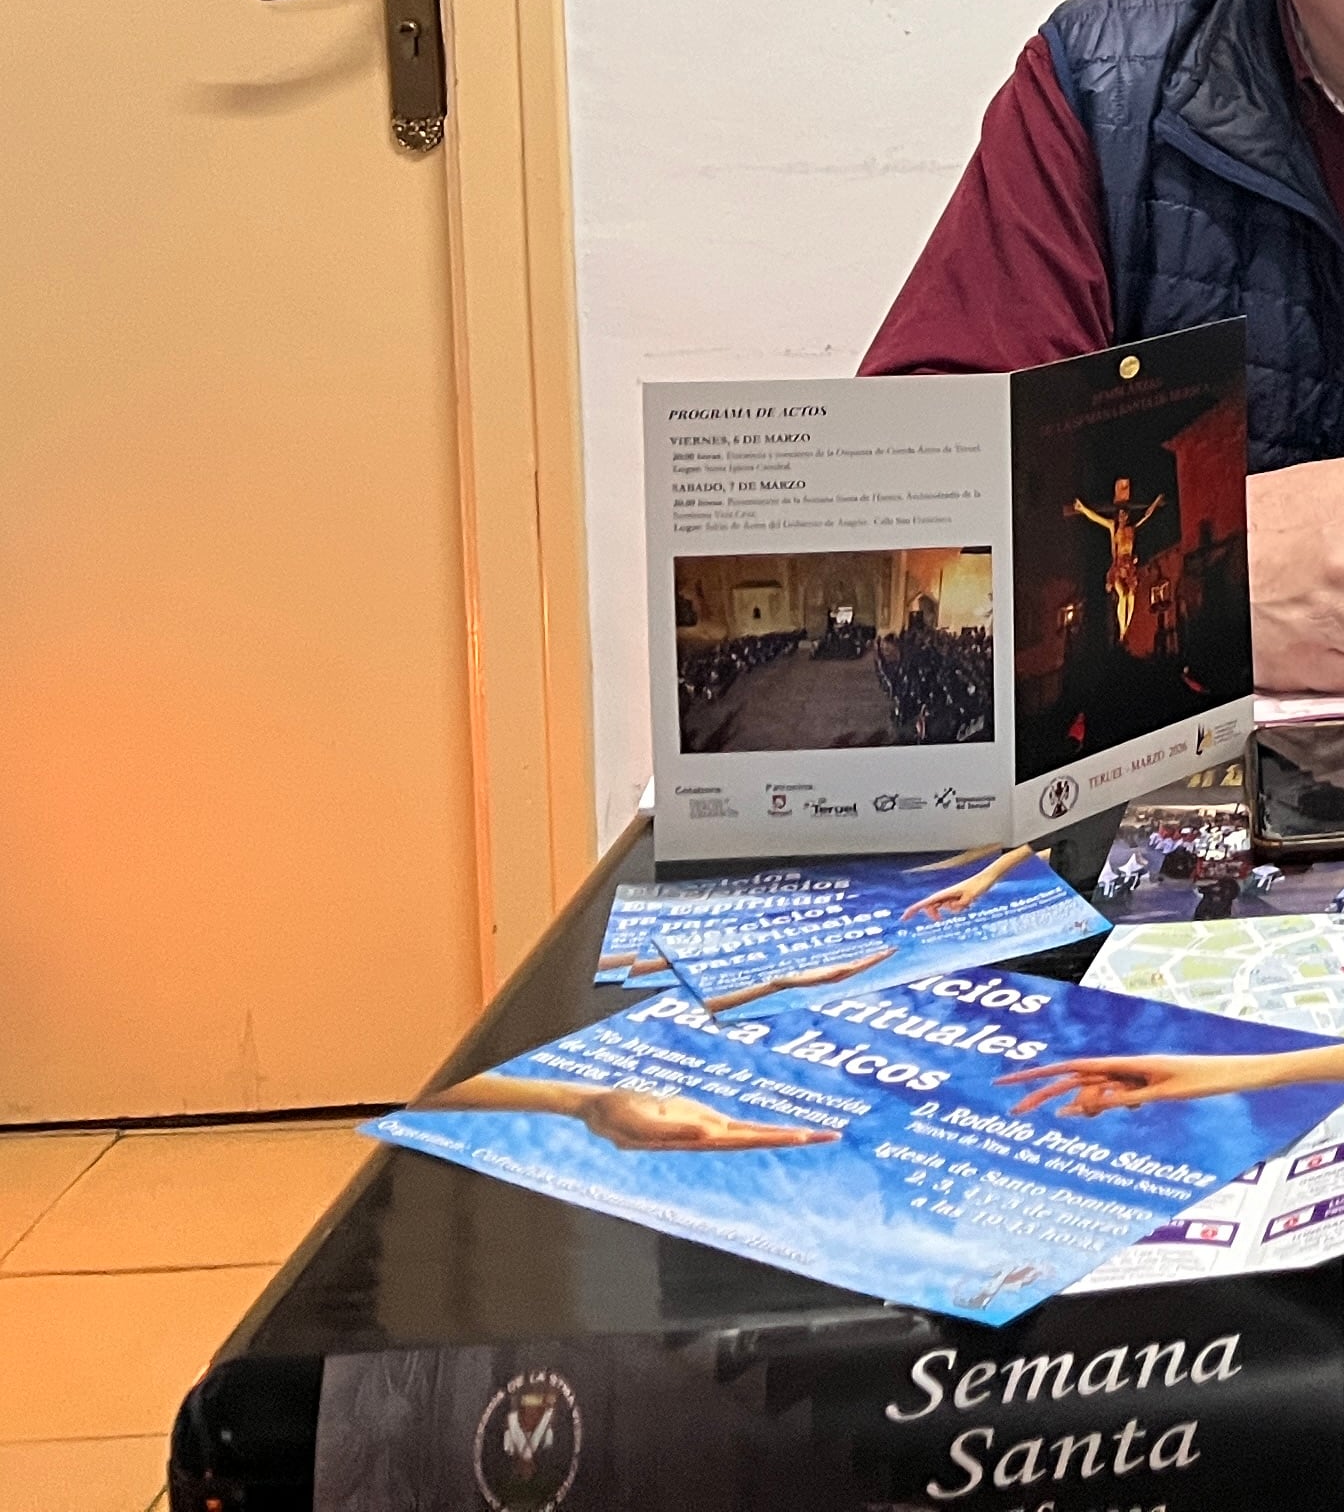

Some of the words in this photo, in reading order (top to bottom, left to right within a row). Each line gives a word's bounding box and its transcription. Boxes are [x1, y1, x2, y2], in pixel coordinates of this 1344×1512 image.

[669, 407, 752, 420] PROGRAMA
[771, 1029, 951, 1091] laicos
[820, 999, 1048, 1061] rituales
[704, 1061, 732, 1076] de
[910, 1101, 933, 1119] D.
[941, 1106, 1036, 1142] Rodolfo
[1031, 1129, 1110, 1161] Prieto
[1110, 1148, 1218, 1188] Sánchez
[874, 1141, 946, 1169] Iglesia
[948, 1161, 979, 1177] de
[980, 1169, 1047, 1196] Santo
[1048, 1186, 1153, 1222] Domingo
[884, 1332, 1243, 1423] Semana
[926, 1416, 1201, 1500] Santa
